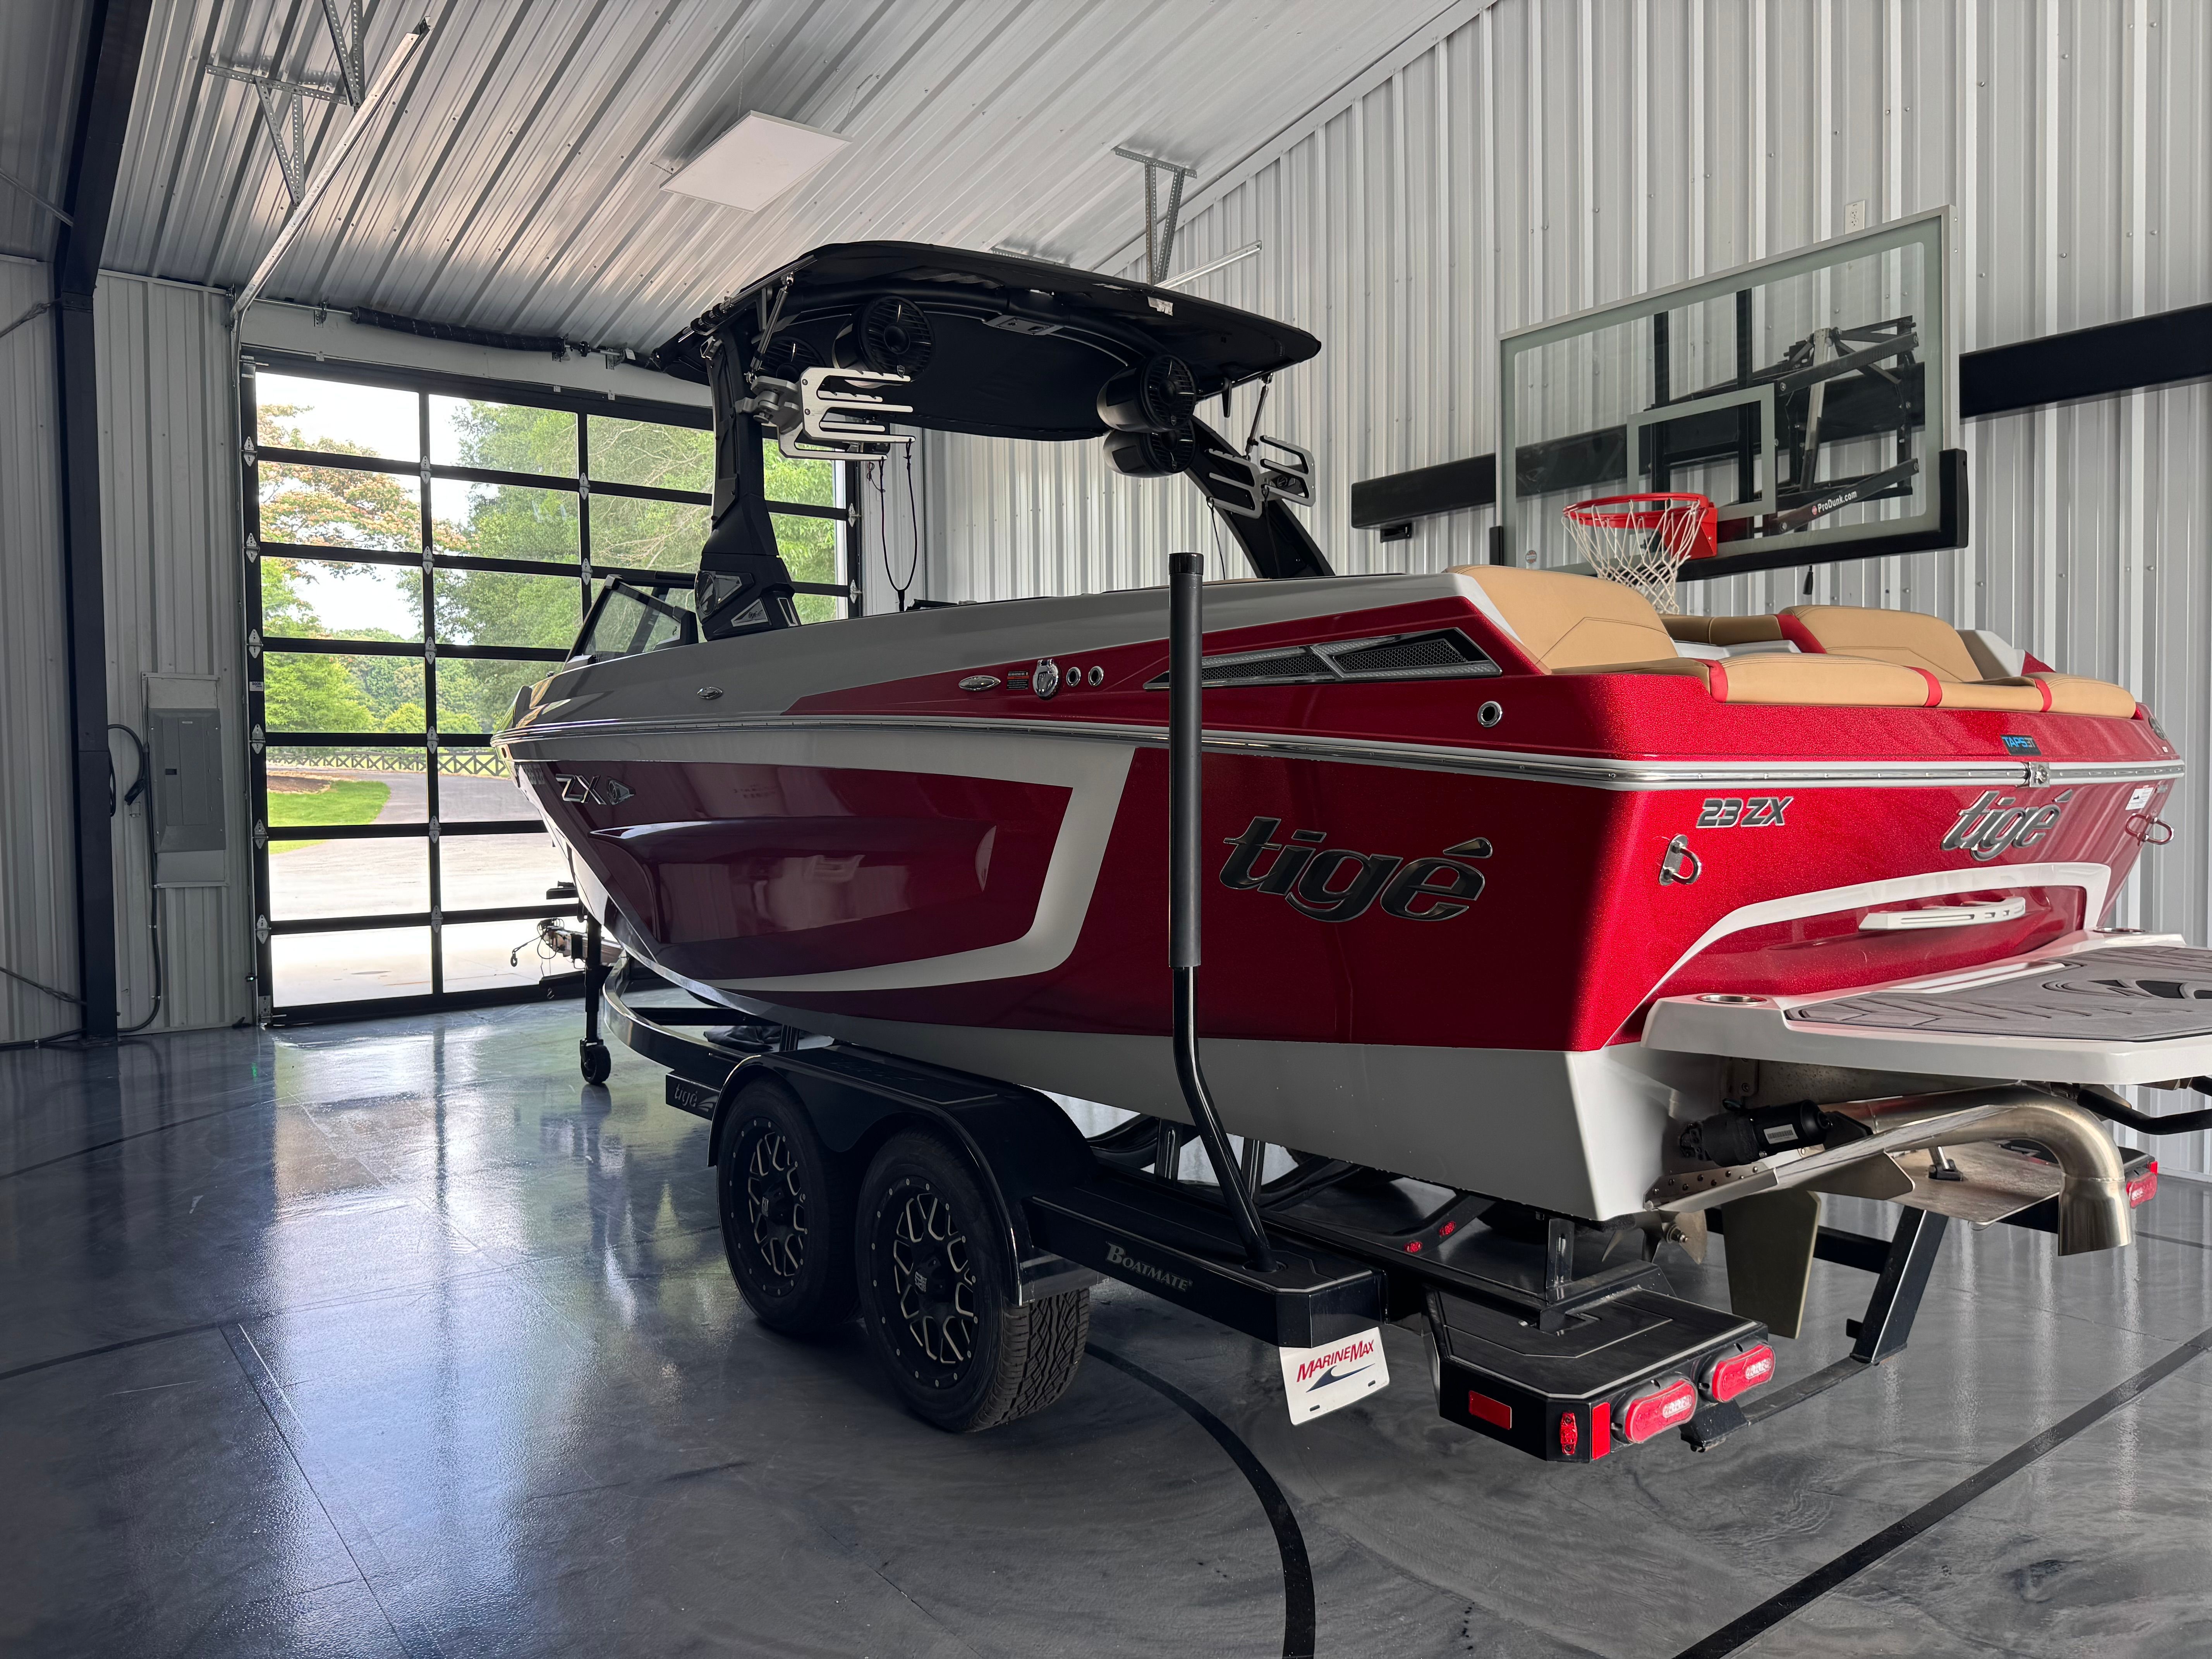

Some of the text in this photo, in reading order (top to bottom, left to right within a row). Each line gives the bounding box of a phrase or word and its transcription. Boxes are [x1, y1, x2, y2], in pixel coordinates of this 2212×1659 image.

[1817, 491, 1857, 513] ProDunk.com
[555, 774, 607, 805] ZX
[1941, 789, 2073, 861] tigé
[1219, 816, 1493, 922] tigé
[674, 1083, 697, 1107] tigé
